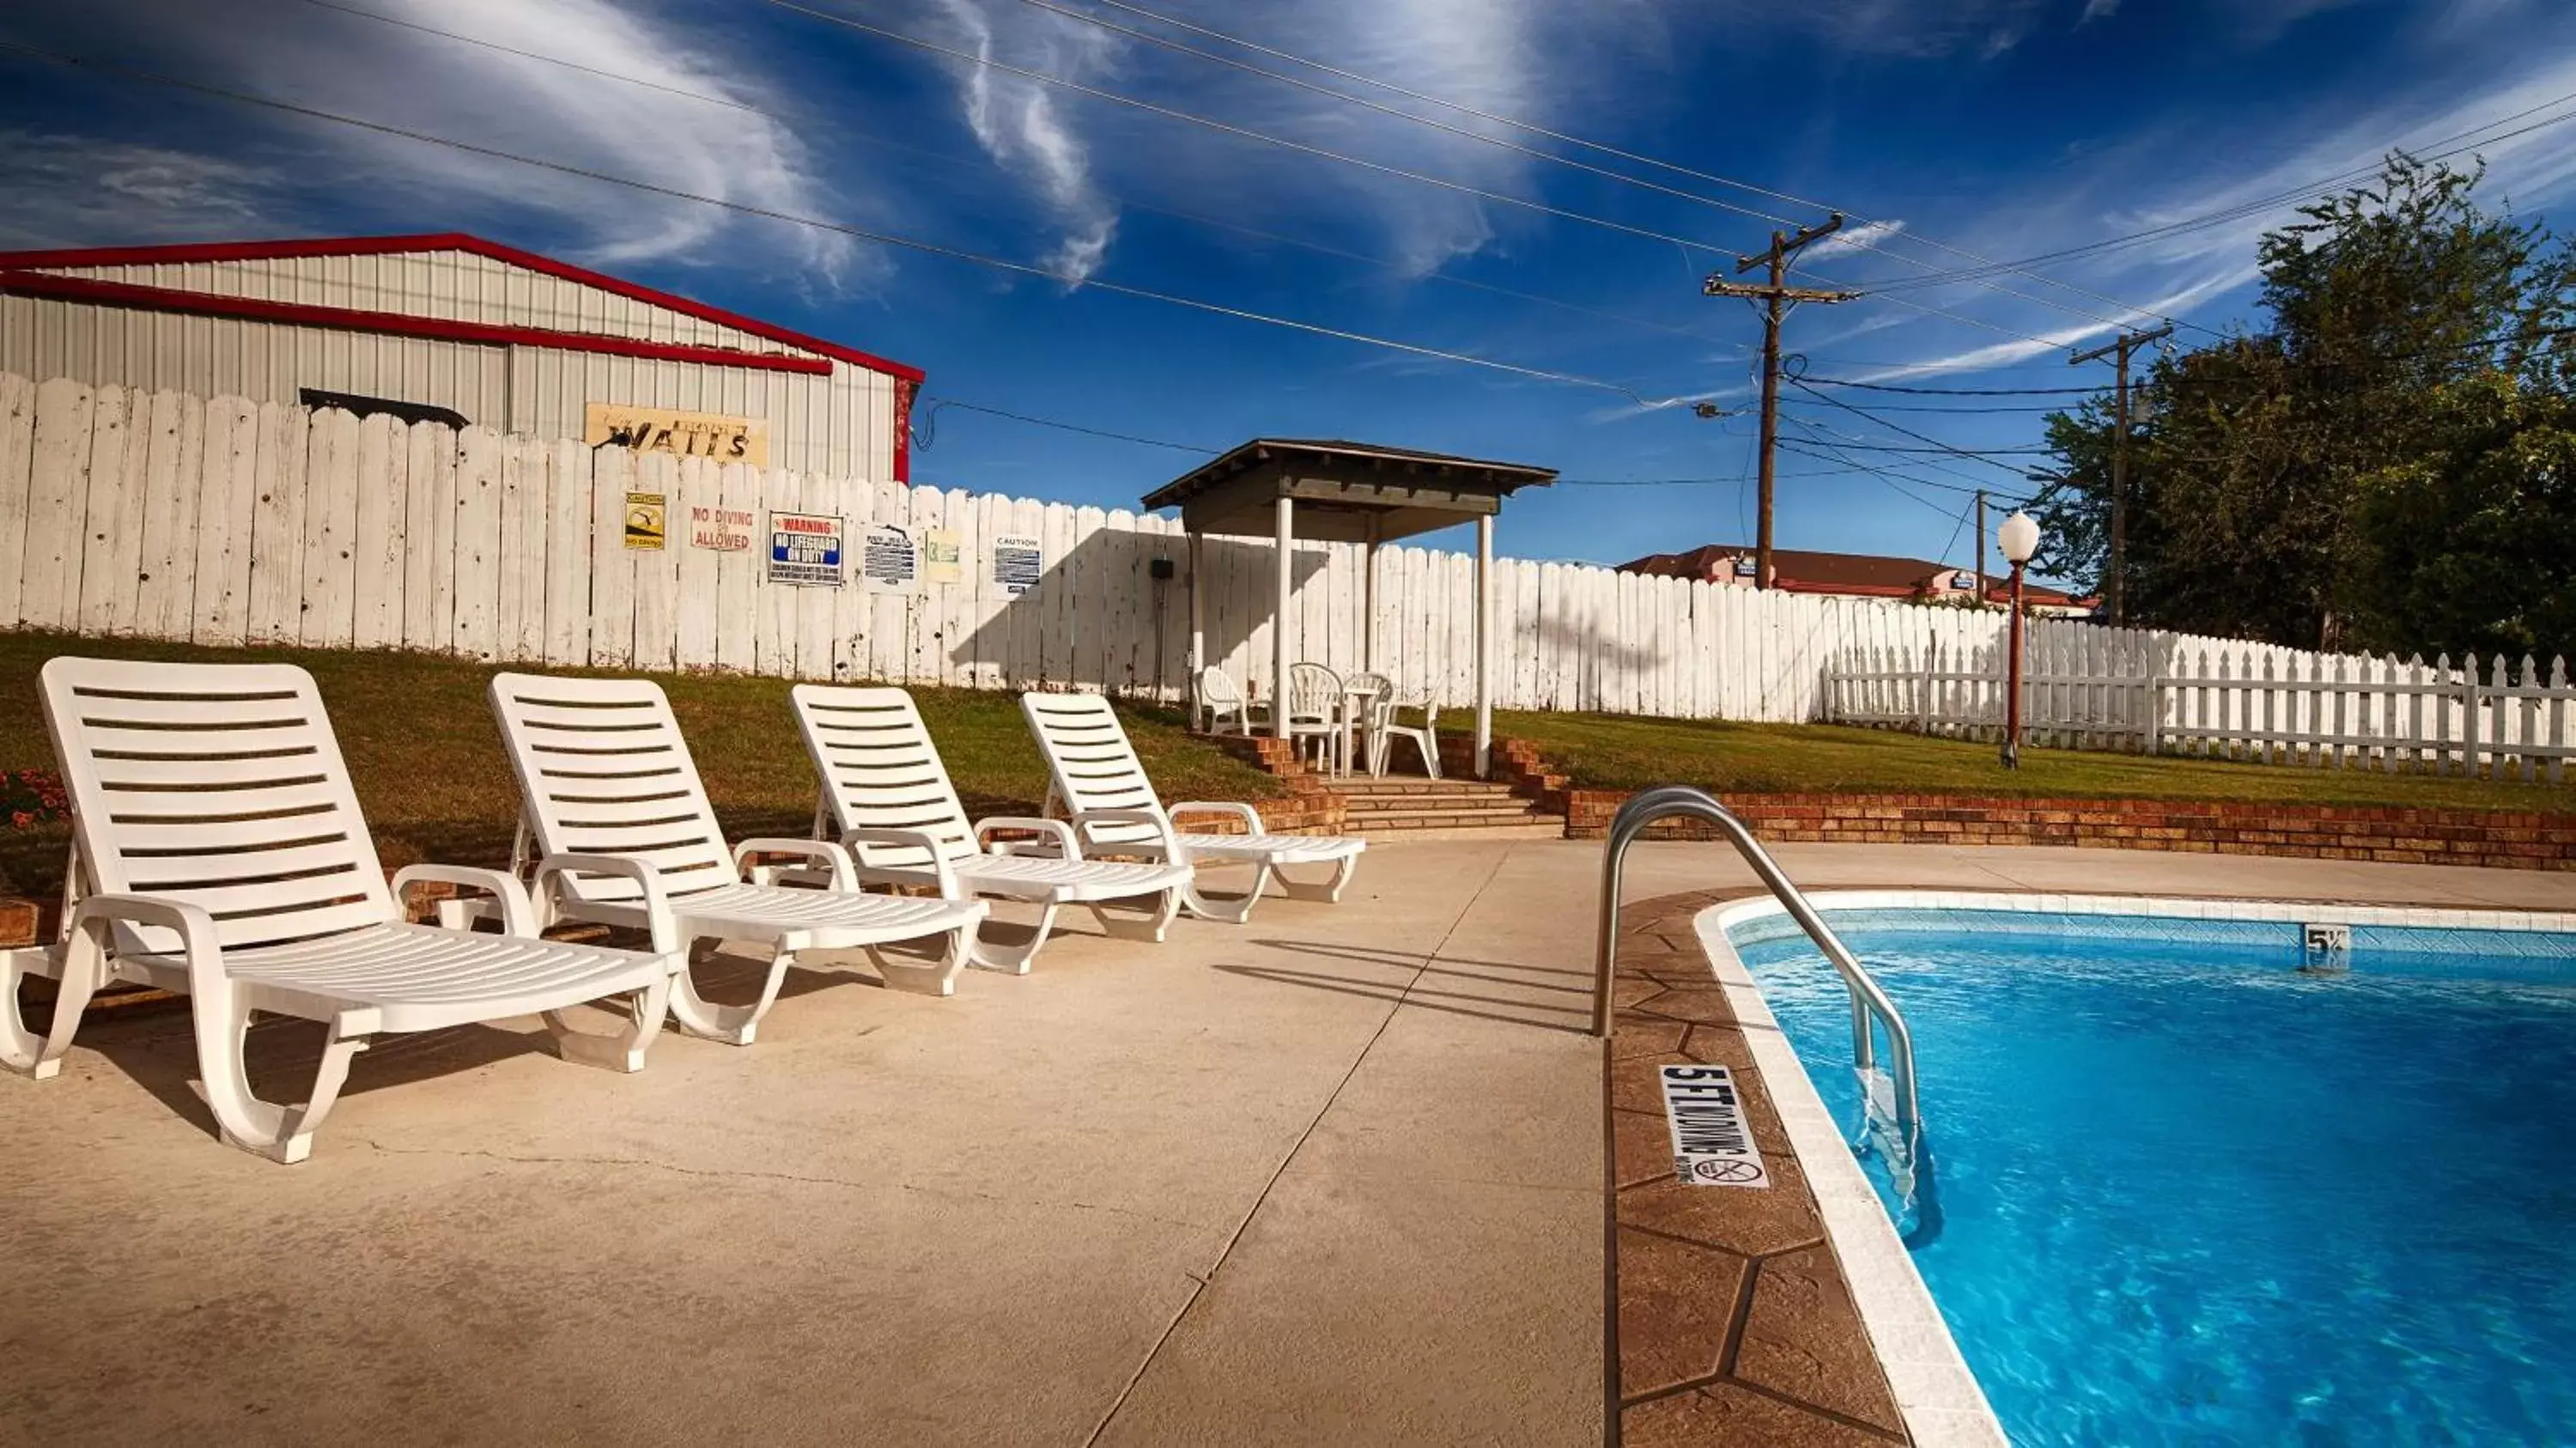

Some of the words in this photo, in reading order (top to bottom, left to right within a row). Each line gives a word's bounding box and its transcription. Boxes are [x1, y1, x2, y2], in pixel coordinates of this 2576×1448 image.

[693, 508, 709, 522] NO
[715, 509, 753, 526] DIVING
[783, 518, 832, 534] WARNING
[695, 530, 749, 548] ALLOWED
[775, 533, 789, 548] NO
[790, 535, 837, 551] LIFEGUARD
[997, 537, 1037, 546] CAUTION
[787, 547, 800, 561] ON
[802, 549, 824, 563] DUTY
[1664, 1068, 1727, 1080] 5
[1674, 1105, 1736, 1118] NO
[1677, 1119, 1748, 1155] DIVING
